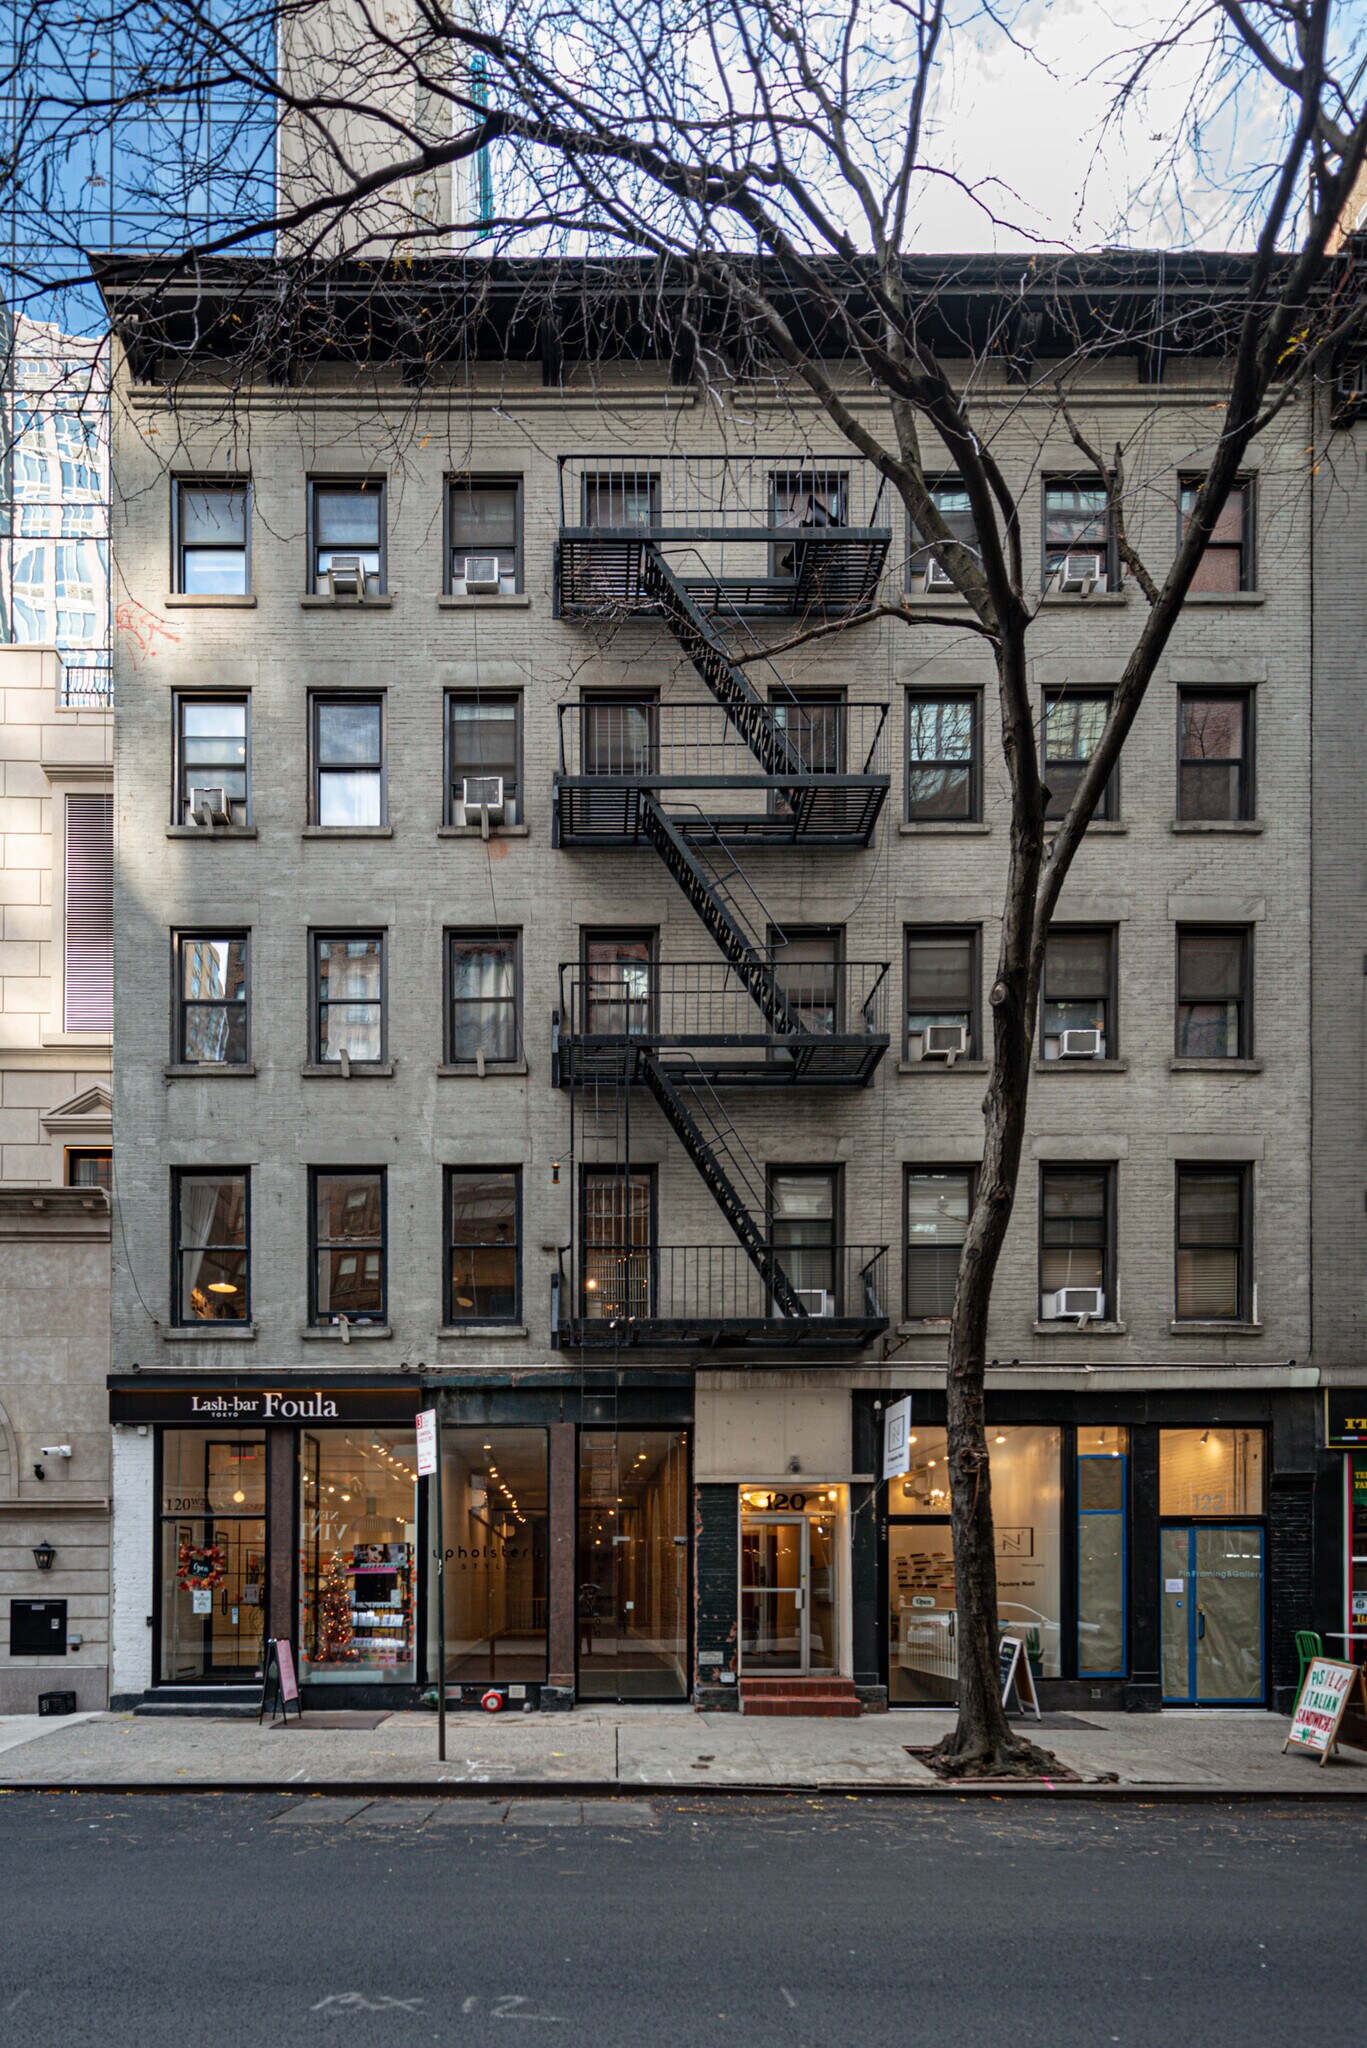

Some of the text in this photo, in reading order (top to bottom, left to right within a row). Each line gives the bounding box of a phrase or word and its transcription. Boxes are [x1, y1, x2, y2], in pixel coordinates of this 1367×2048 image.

[191, 1391, 339, 1417] Lash-bar Foula
[1354, 1471, 1367, 1479] TE
[167, 1498, 191, 1511] 120
[766, 1493, 807, 1511] 120
[1195, 1494, 1224, 1511] 122
[193, 1562, 209, 1573] Open
[1303, 1690, 1340, 1712] ITALIAN
[1295, 1708, 1336, 1733] SANDWICHES
